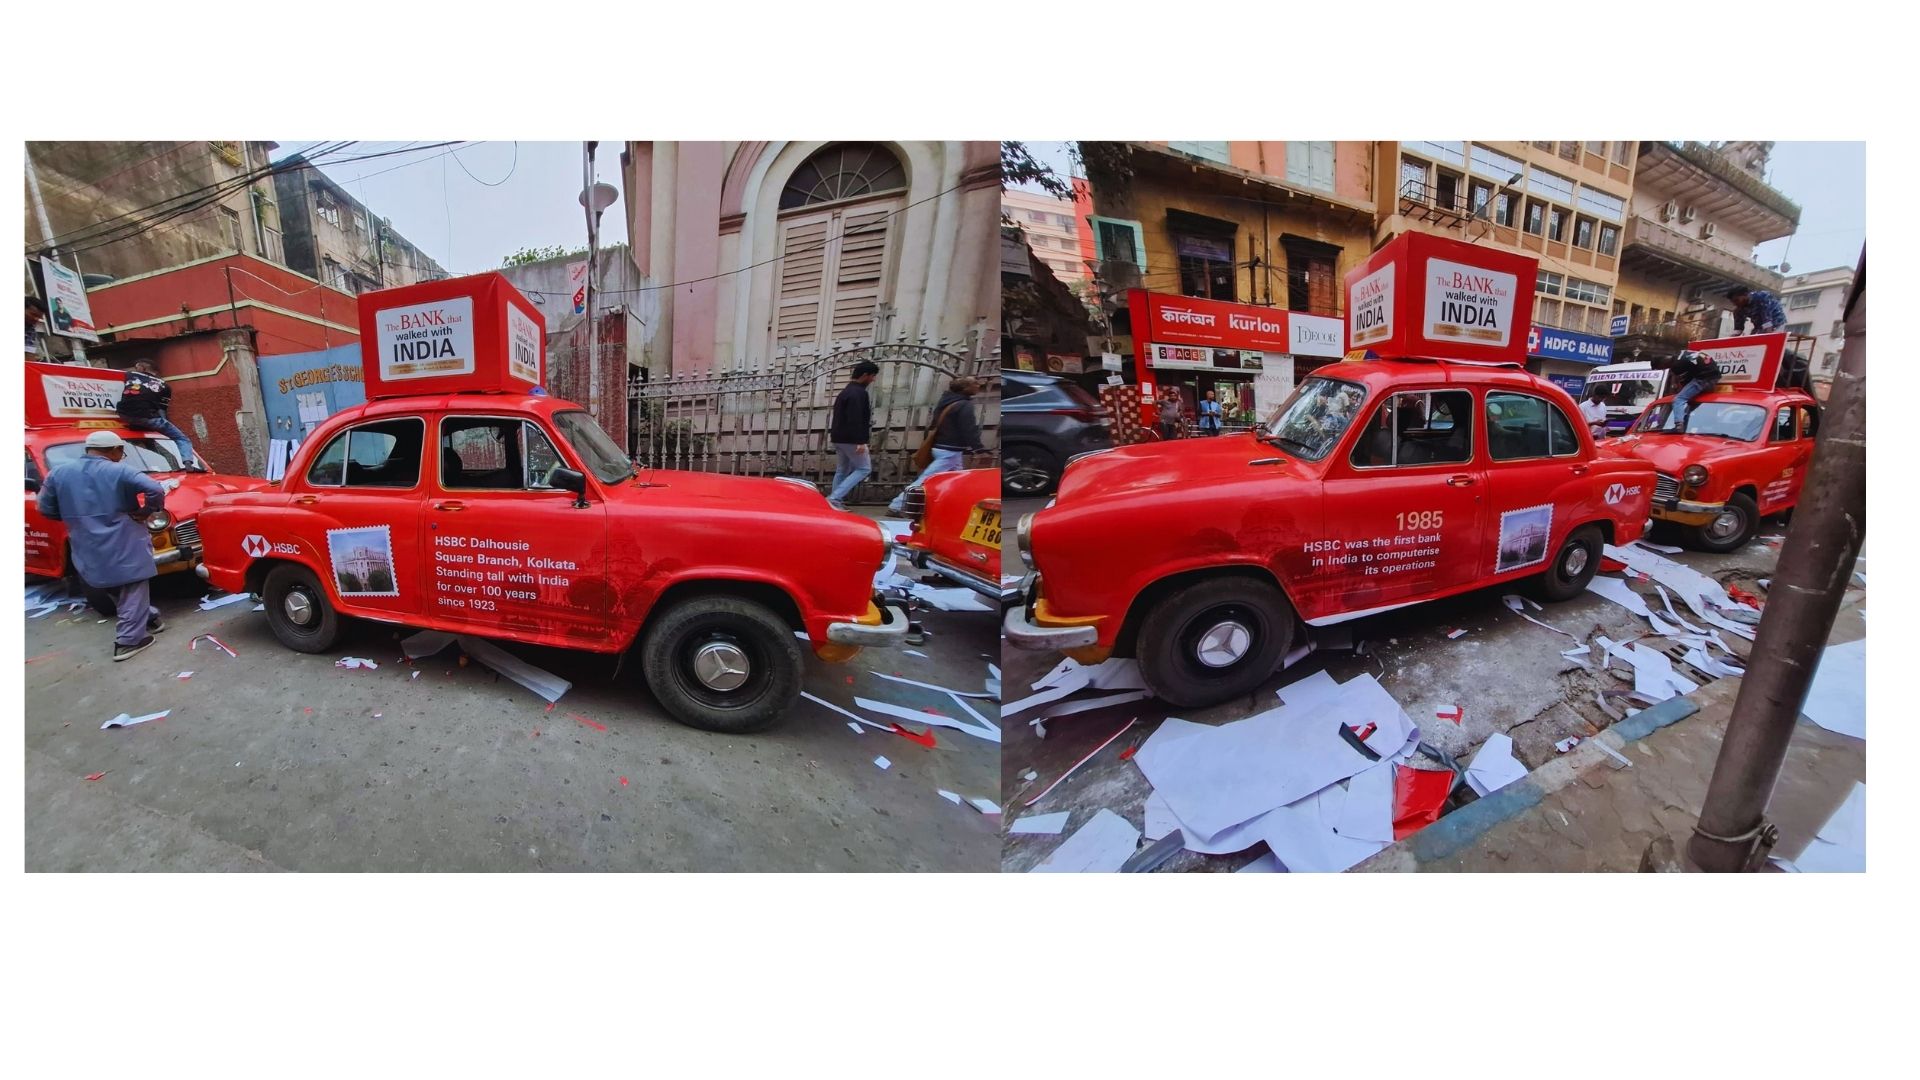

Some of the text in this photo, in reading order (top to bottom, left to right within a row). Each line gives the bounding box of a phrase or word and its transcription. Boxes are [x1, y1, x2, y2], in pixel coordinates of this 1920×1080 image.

[1360, 279, 1381, 301] BANK
[1436, 272, 1506, 296] The BANK that
[1446, 291, 1497, 306] walked with
[385, 310, 461, 332] The BANK that
[1229, 313, 1281, 334] kurlon
[1356, 305, 1384, 331] INDIA
[1441, 301, 1497, 328] INDIA
[1612, 320, 1626, 328] ATM
[396, 326, 452, 341] walked with
[394, 338, 456, 362] INDIA
[515, 342, 536, 368] INDIA
[1159, 347, 1206, 362] SPACES
[1544, 336, 1610, 358] HDFC BANK
[1590, 371, 1660, 381] FRIEND TRAVELS
[67, 381, 105, 392] BANK
[62, 396, 115, 409] INDIA
[1626, 485, 1641, 496] HSBC
[1396, 510, 1444, 531] 1985
[972, 525, 981, 538] F
[273, 542, 301, 555] HSBC
[435, 536, 530, 551] HSBC Dalhousie
[1303, 532, 1442, 553] HSBC was the first bank
[435, 551, 580, 571] Square Branch, Kolkata.
[1312, 546, 1440, 567] in India to computerise
[436, 566, 569, 586] Standing tall with India
[1365, 560, 1436, 575] its operations
[437, 581, 537, 600] for over 100 years
[438, 596, 499, 612] since 1923.
